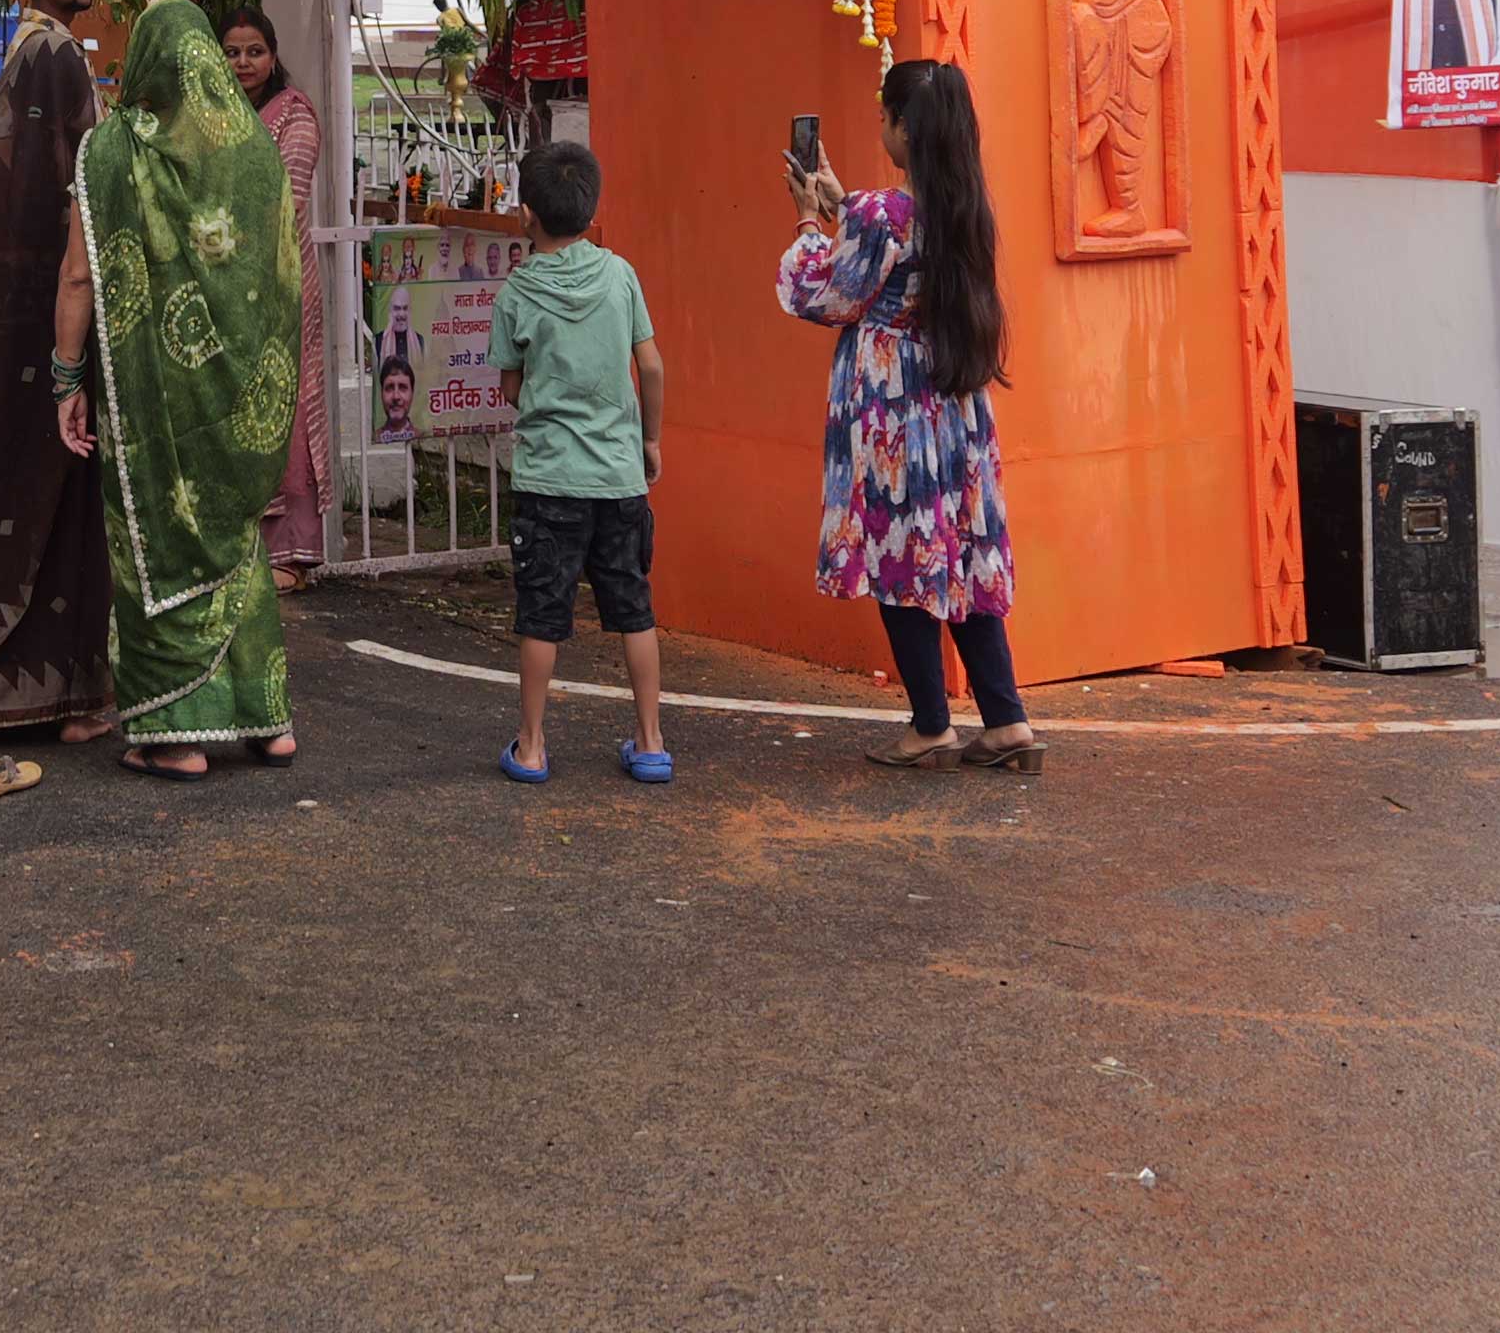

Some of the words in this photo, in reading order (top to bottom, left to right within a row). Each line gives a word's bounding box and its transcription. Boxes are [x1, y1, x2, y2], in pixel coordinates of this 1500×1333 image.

[1407, 70, 1451, 95] जीवेश
[1452, 72, 1500, 100] कुमार
[454, 294, 474, 307] माता
[431, 322, 450, 335] भव्य
[449, 349, 471, 367] आये
[430, 380, 482, 413] हार्दिक
